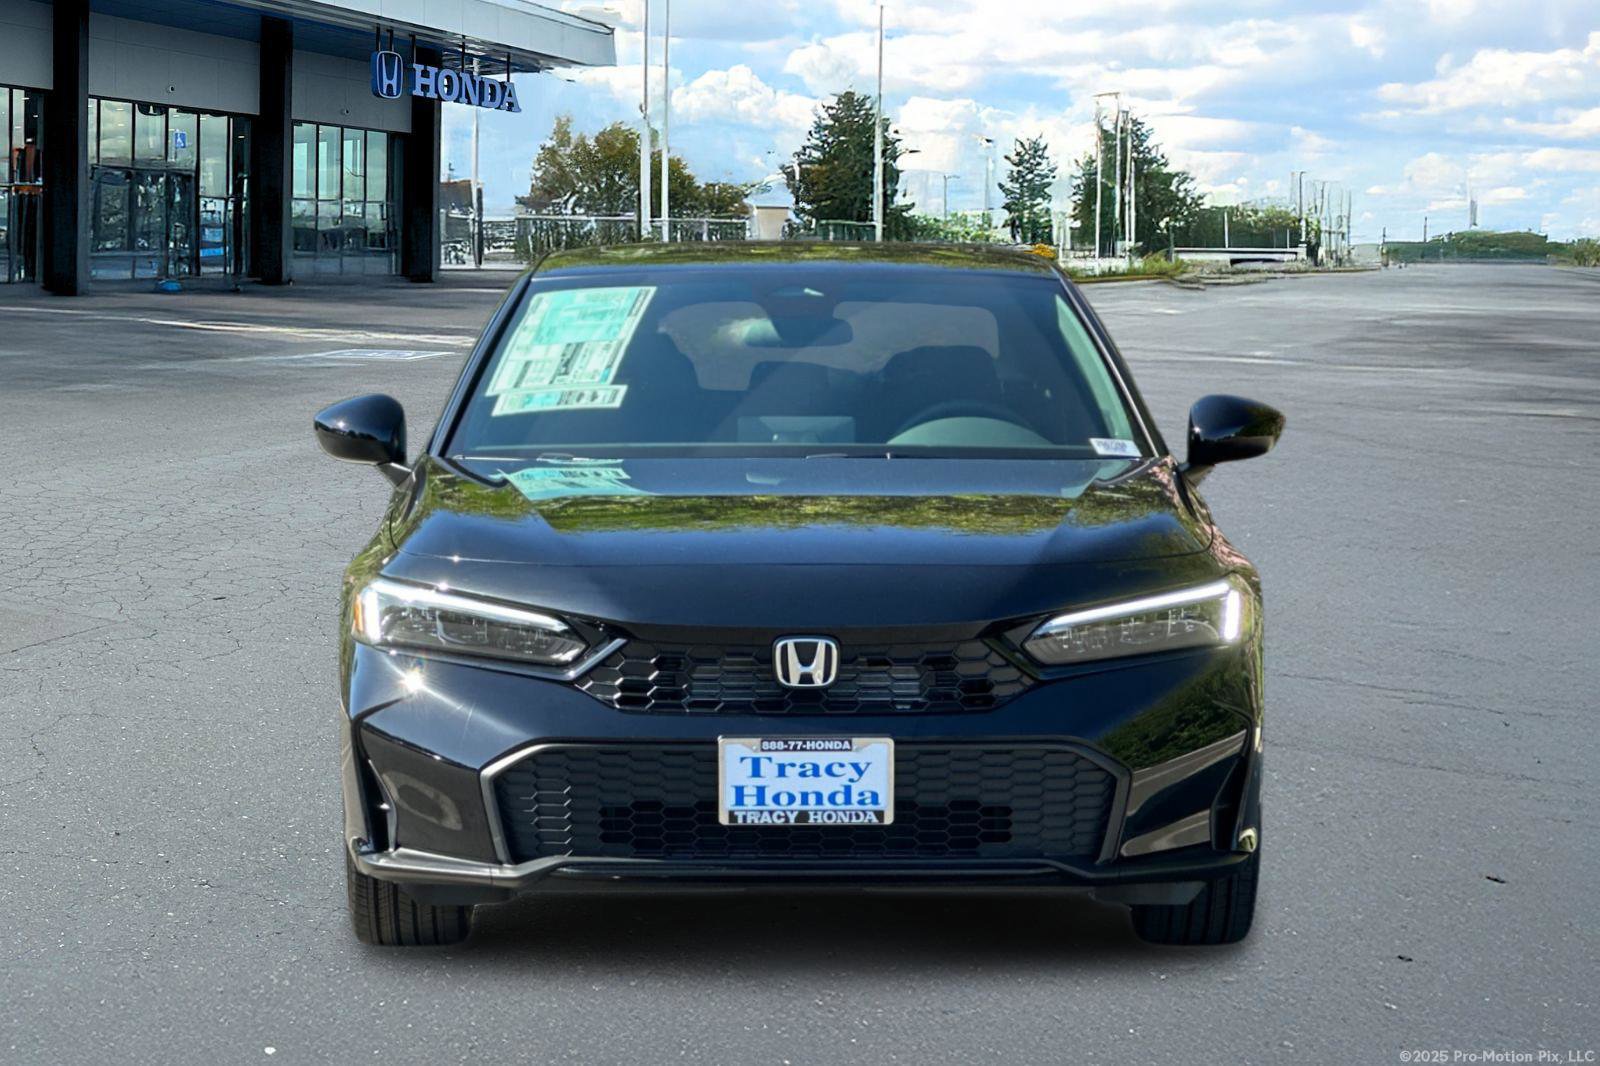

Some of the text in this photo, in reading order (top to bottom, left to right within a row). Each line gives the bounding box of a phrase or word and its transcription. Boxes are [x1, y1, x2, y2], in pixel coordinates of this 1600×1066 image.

[412, 62, 521, 112] HONDA
[762, 740, 851, 750] 888-77-HONDA
[740, 756, 872, 783] Tracy
[731, 784, 881, 807] Honda
[734, 811, 879, 824] TRACY HONDA
